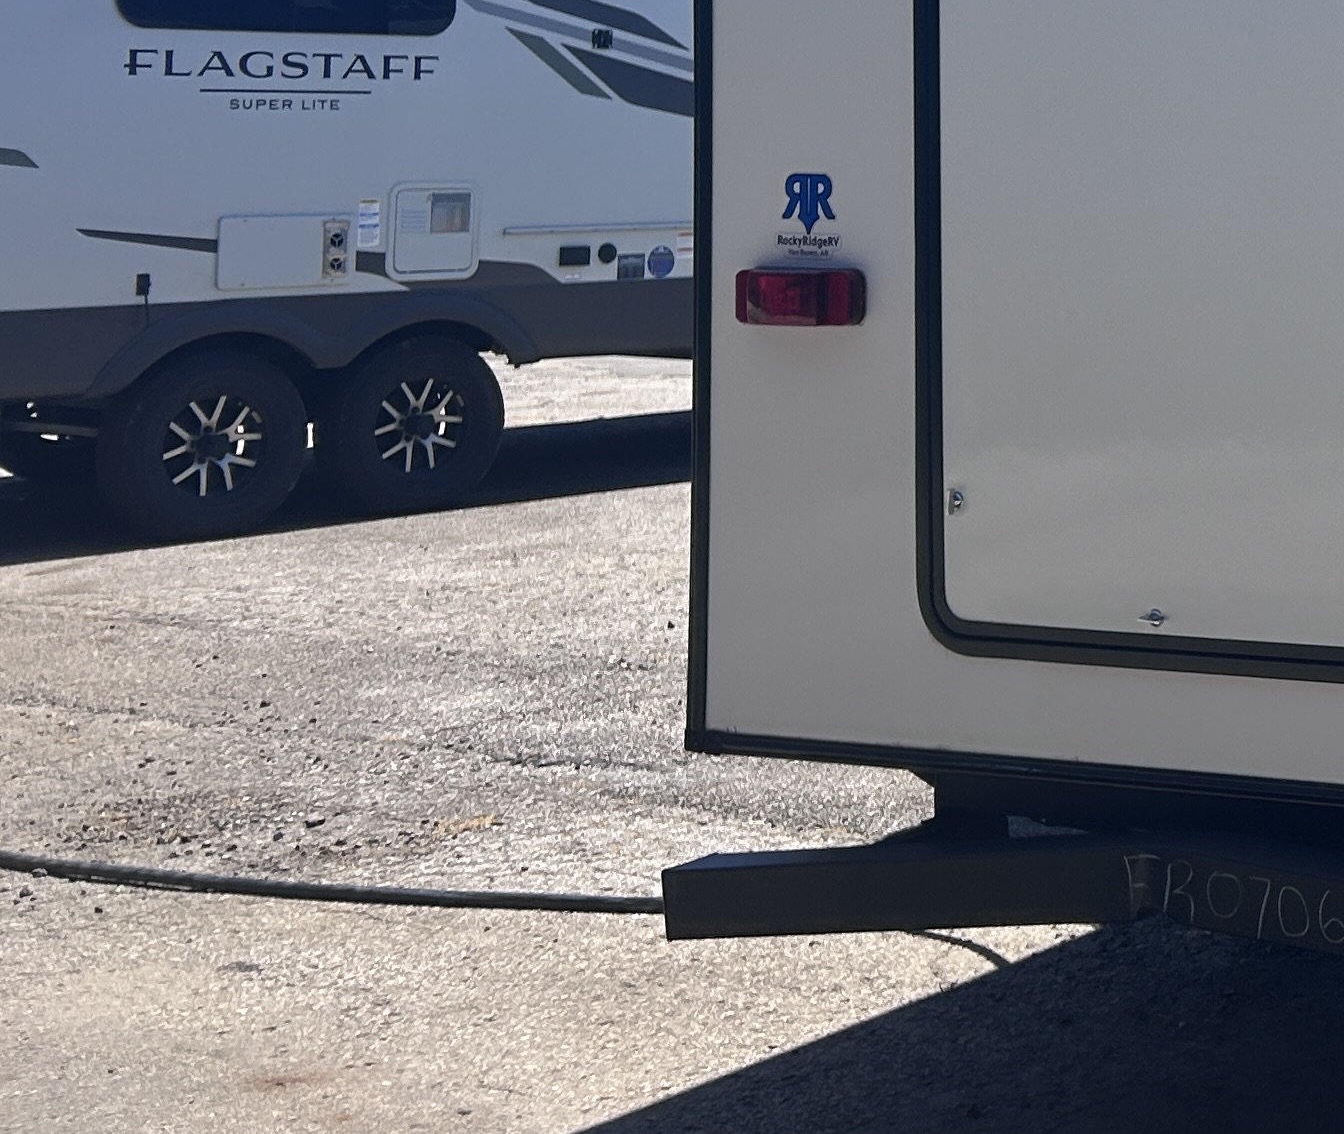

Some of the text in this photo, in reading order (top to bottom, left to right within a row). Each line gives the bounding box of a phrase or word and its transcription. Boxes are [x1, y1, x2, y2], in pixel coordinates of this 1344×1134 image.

[124, 48, 440, 81] FLAGSTAFF
[229, 98, 340, 111] SUPER LITE
[777, 234, 840, 250] RockyRidgeRV
